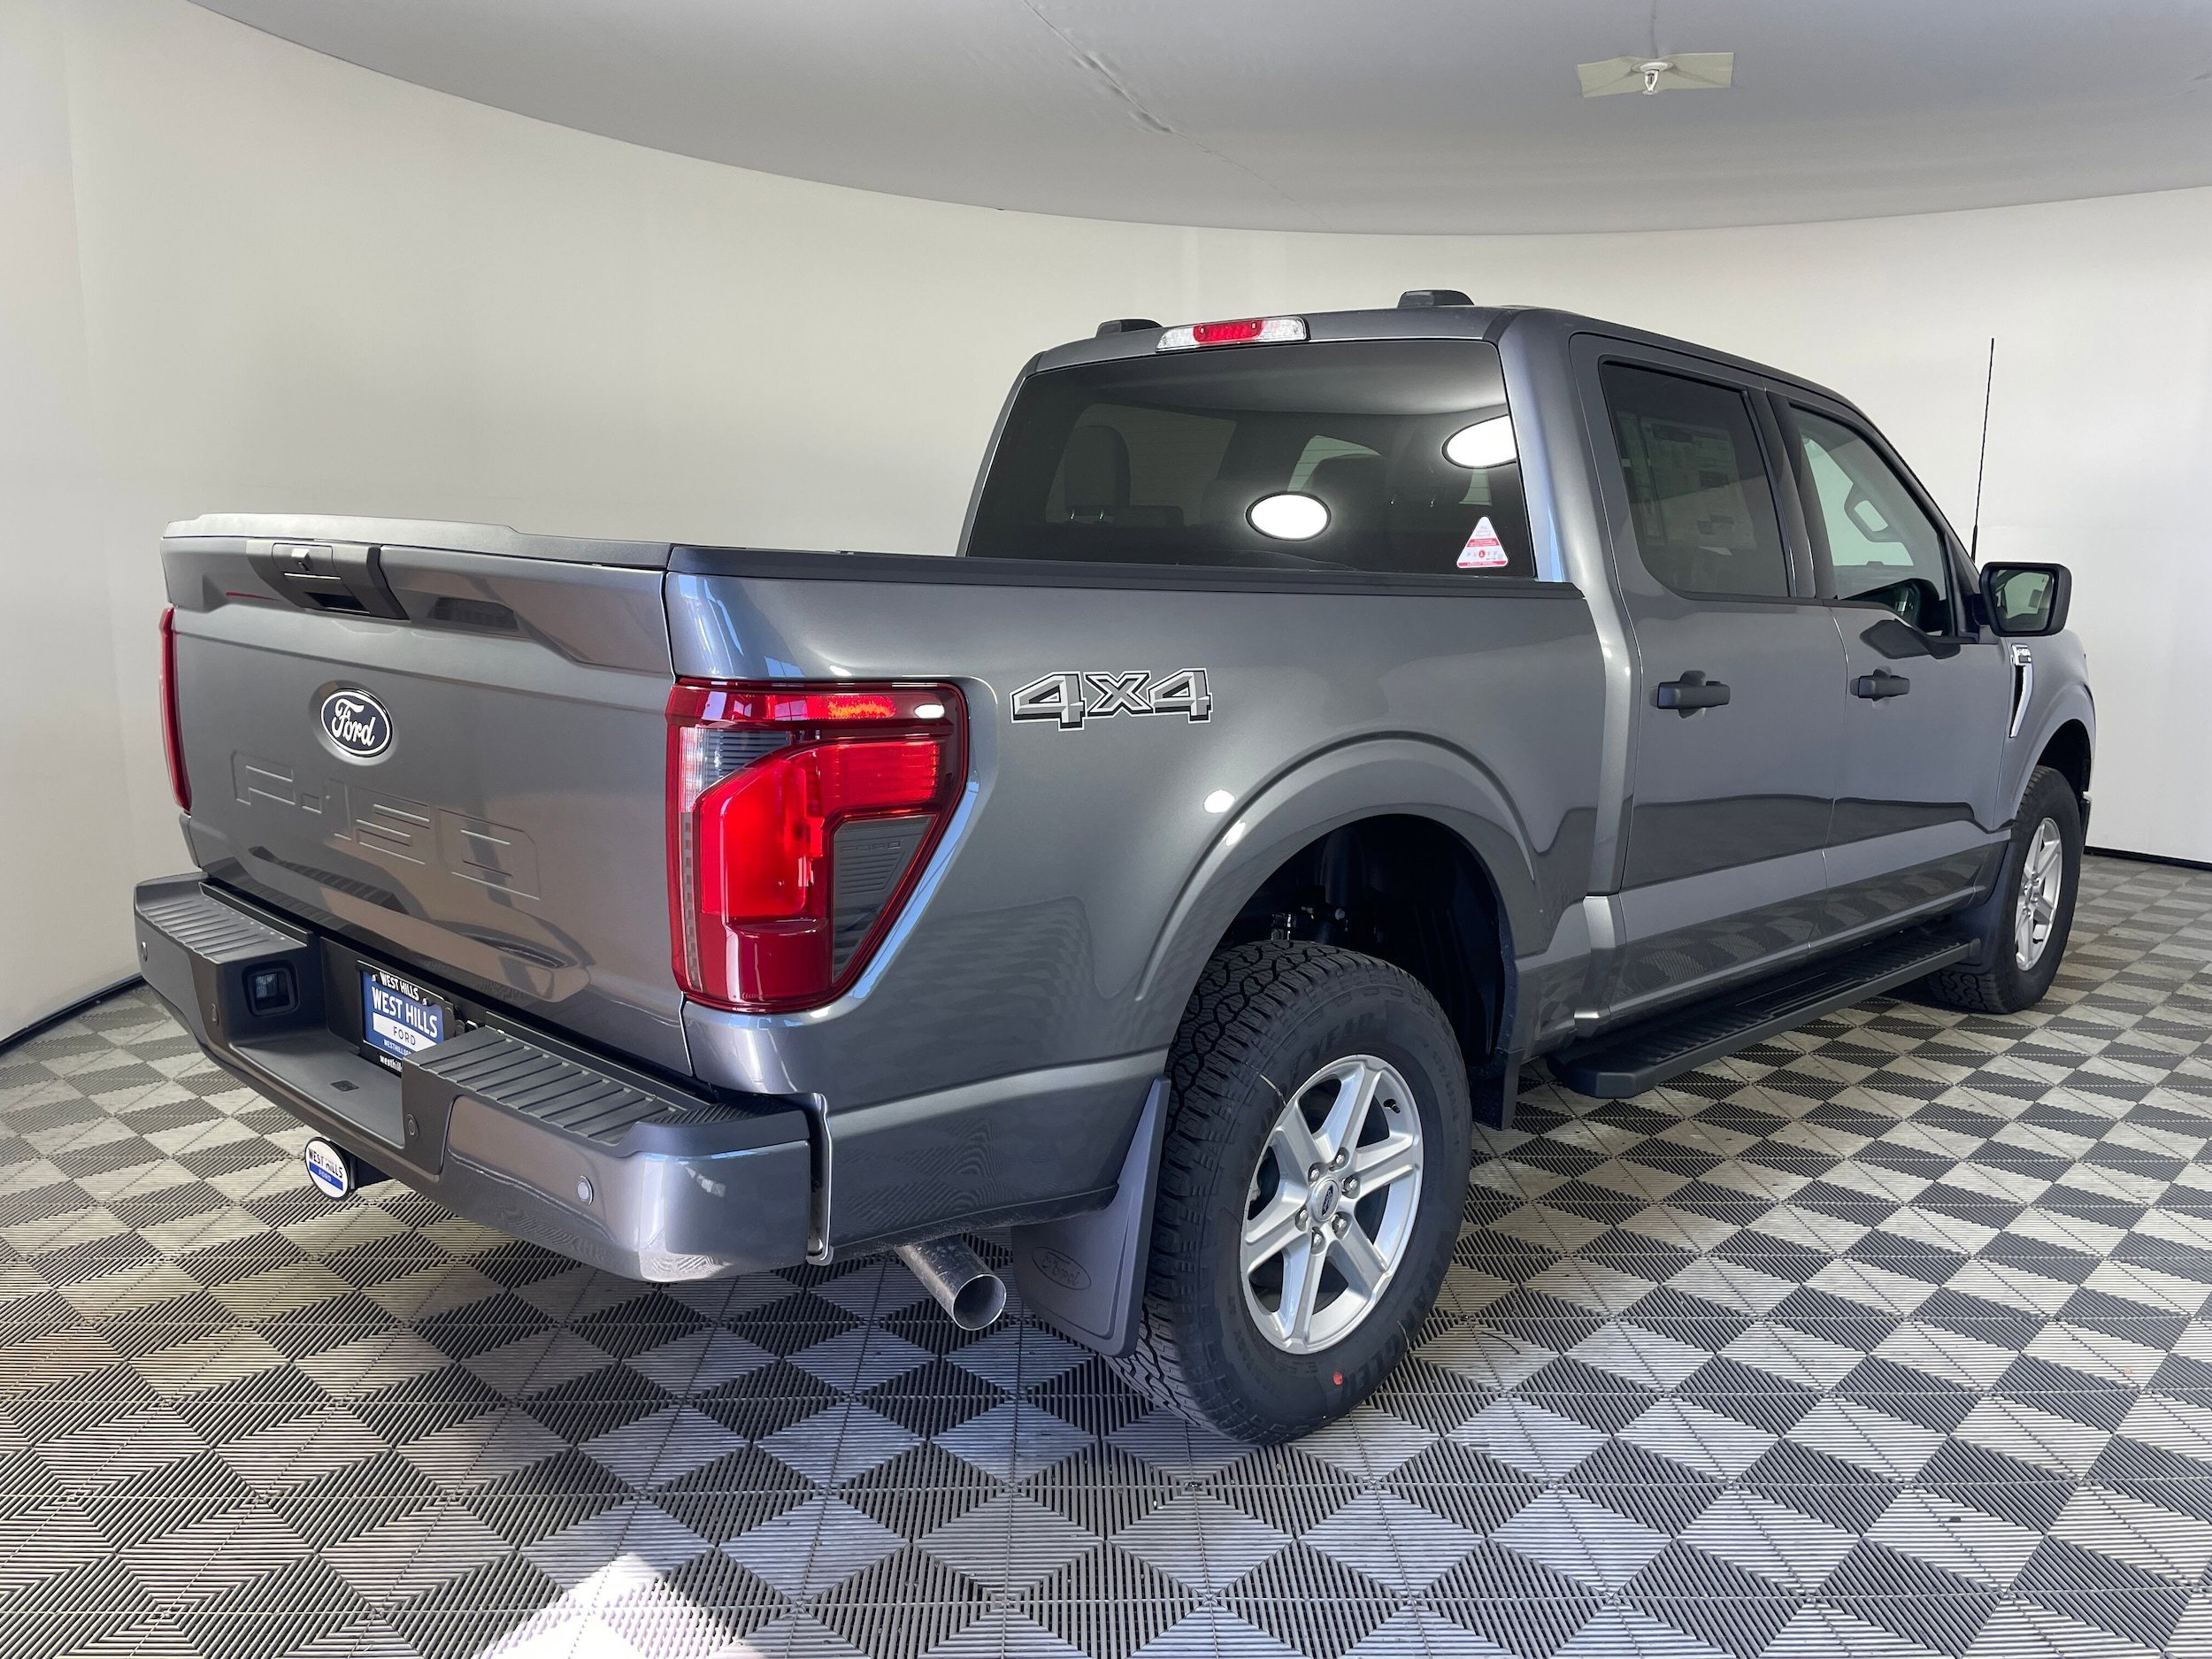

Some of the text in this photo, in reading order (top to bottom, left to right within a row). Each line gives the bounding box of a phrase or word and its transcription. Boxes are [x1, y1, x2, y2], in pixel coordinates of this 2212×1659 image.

[331, 698, 376, 747] Ford
[380, 971, 420, 1002] WEST HILLS
[372, 986, 438, 1039] WEST HILLS
[393, 1026, 416, 1046] FORD
[308, 1148, 343, 1179] WEST HILLS
[319, 1169, 332, 1183] FORD
[1041, 1250, 1080, 1287] Ford
